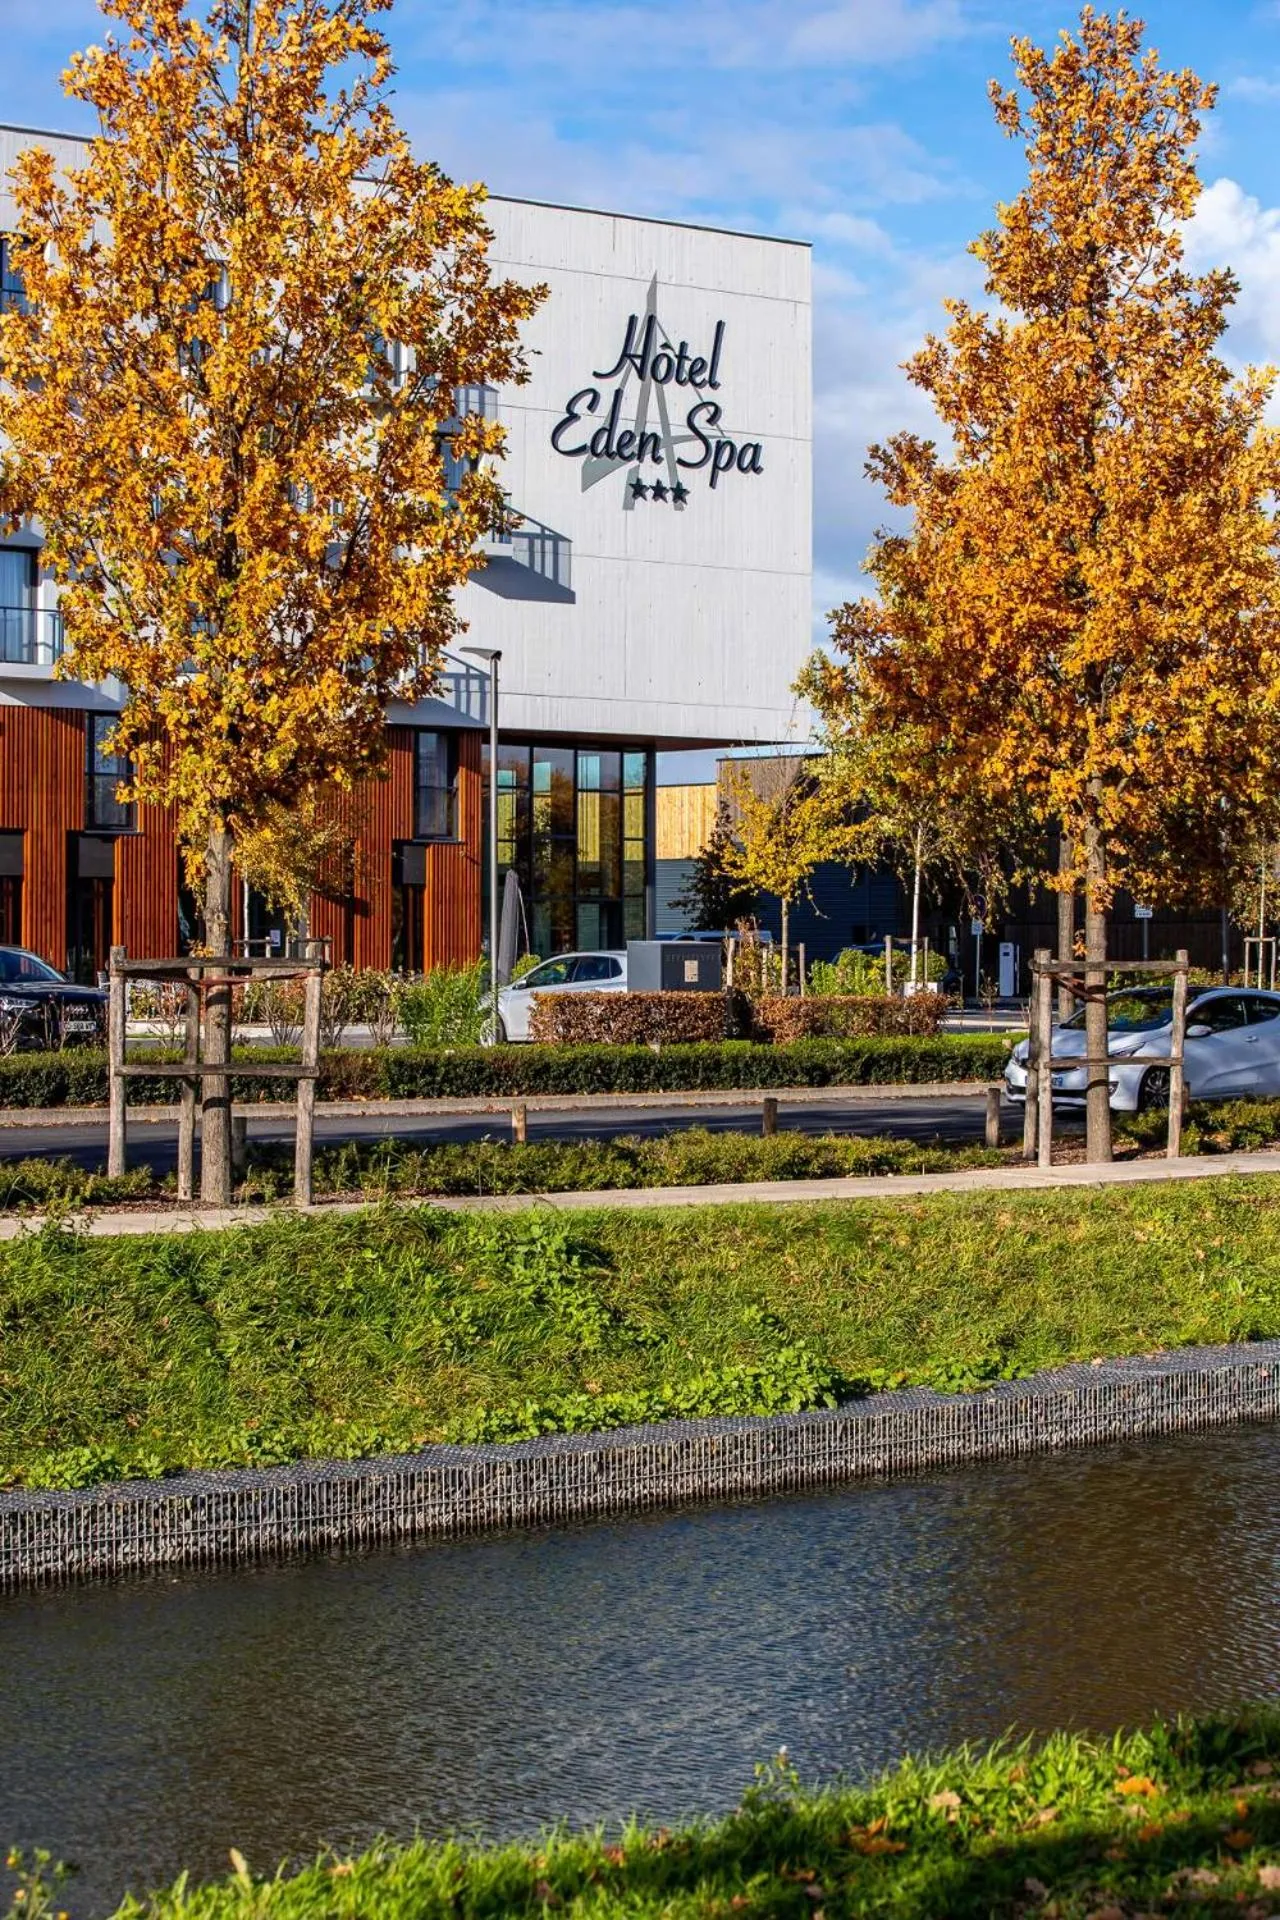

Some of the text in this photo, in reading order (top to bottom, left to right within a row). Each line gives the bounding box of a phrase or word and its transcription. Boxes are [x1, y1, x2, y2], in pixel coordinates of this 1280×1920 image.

[592, 314, 726, 390] Hôtel
[550, 387, 764, 490] Eden Spa
